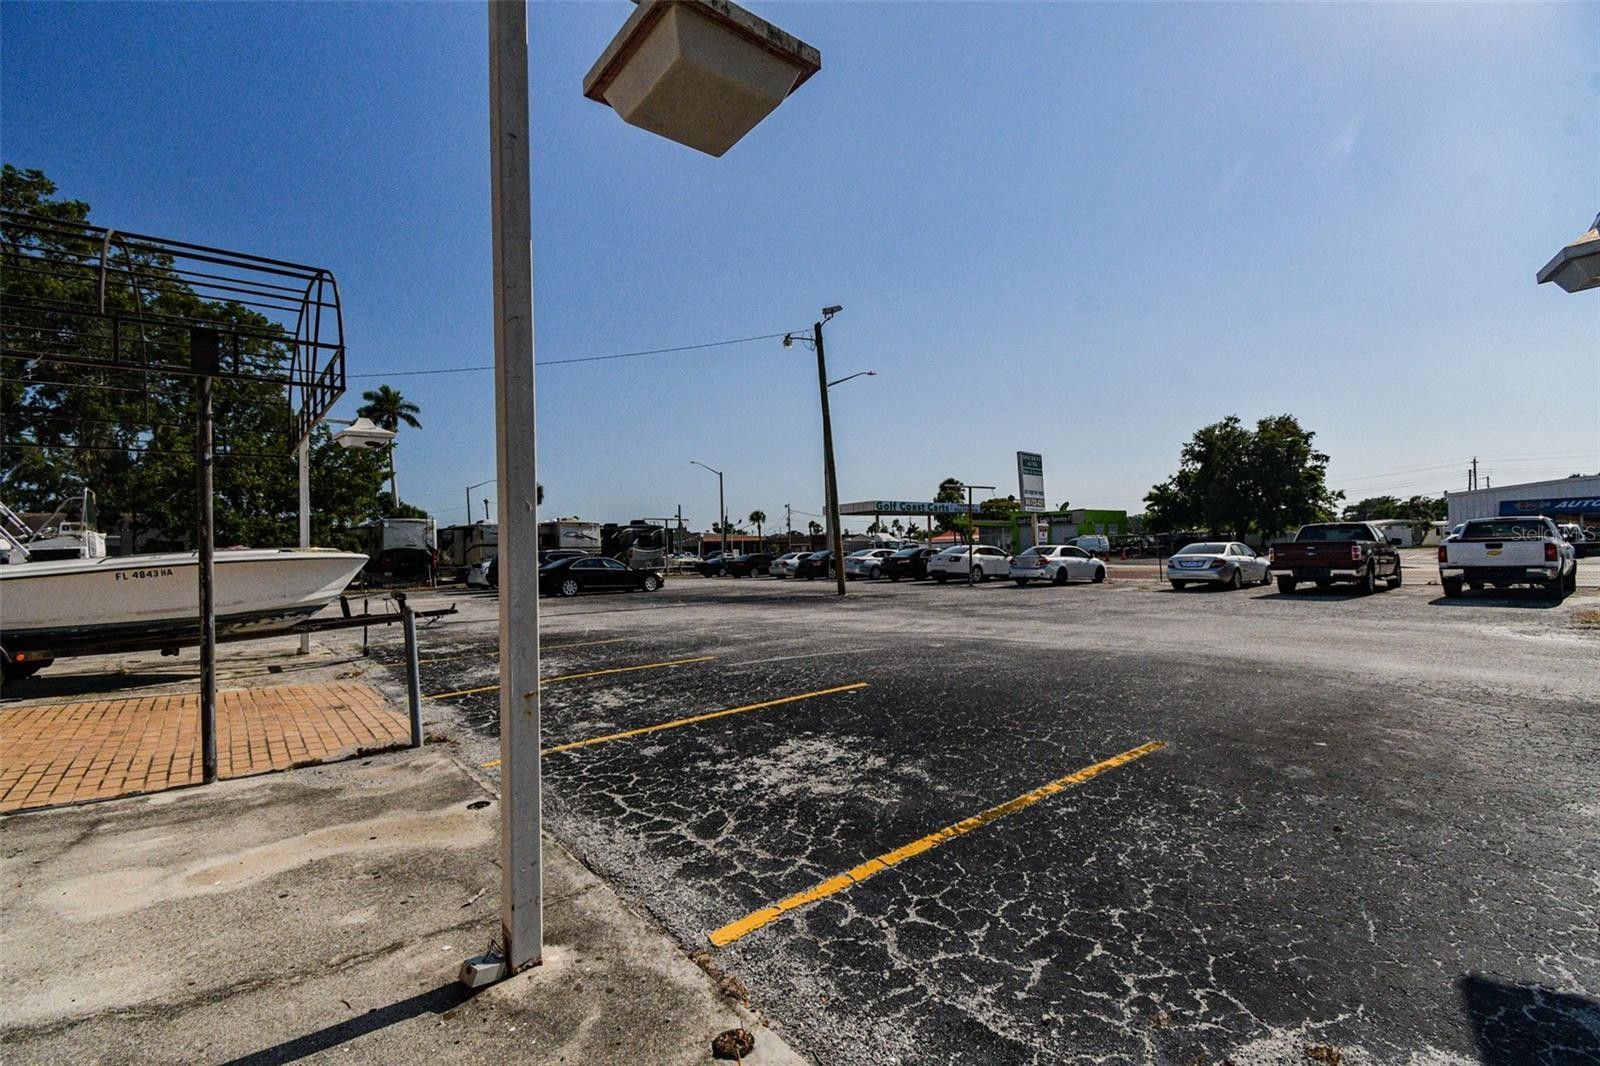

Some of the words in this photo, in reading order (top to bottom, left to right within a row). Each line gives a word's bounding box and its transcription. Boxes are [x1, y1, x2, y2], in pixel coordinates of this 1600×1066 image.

[876, 501, 897, 511] Golf
[899, 502, 925, 511] Coast
[927, 503, 950, 512] Carts
[115, 572, 129, 581] FL
[131, 569, 159, 579] 4843
